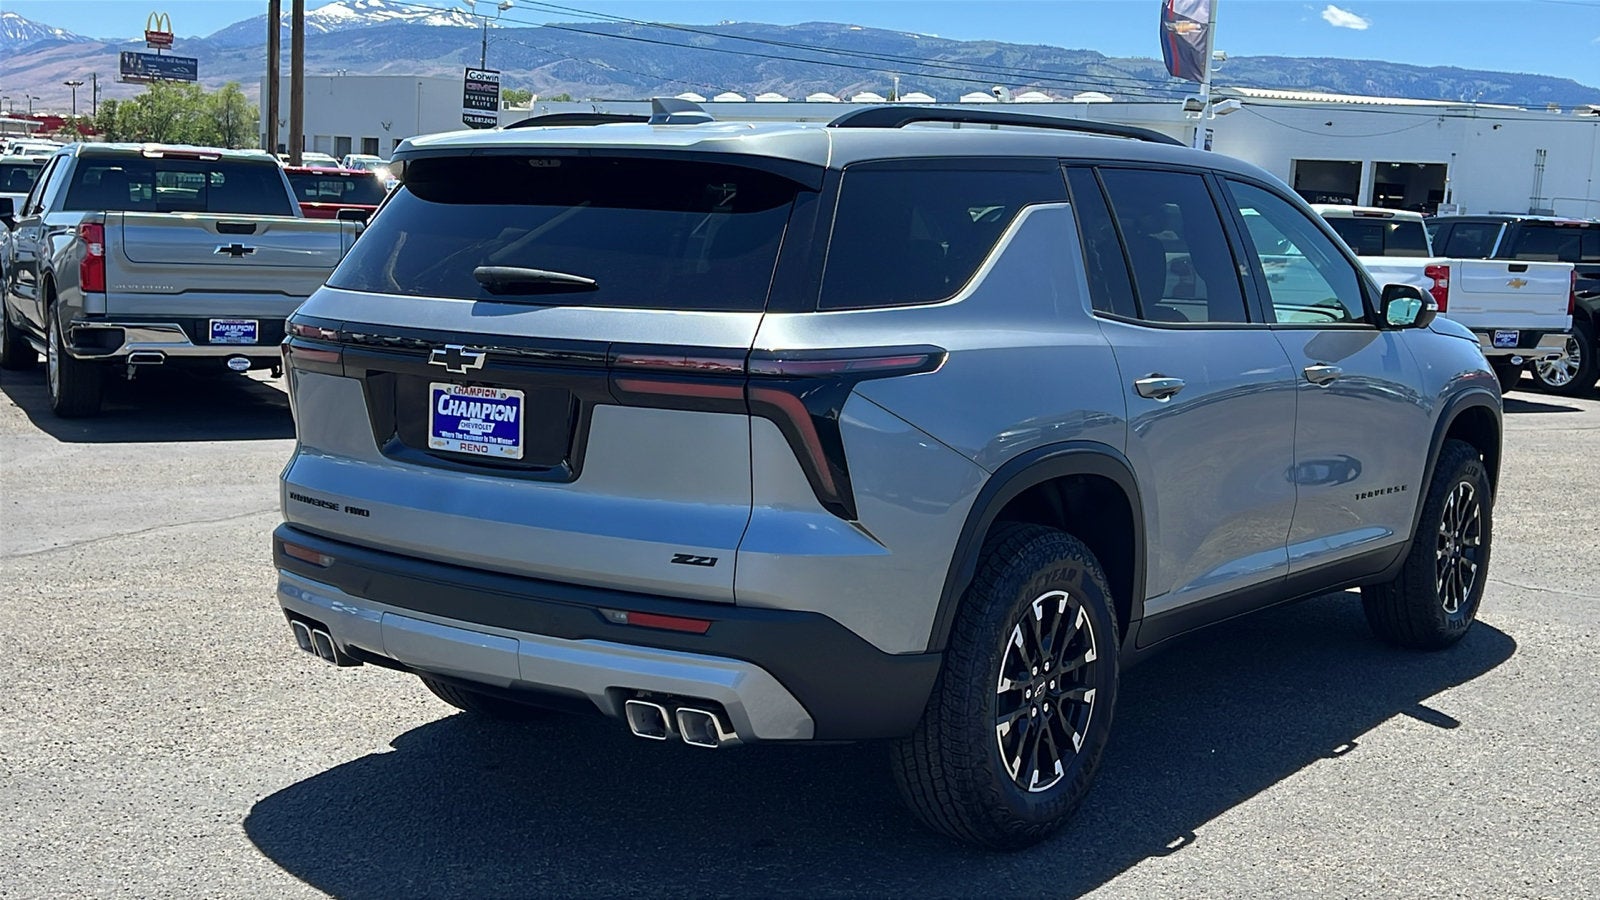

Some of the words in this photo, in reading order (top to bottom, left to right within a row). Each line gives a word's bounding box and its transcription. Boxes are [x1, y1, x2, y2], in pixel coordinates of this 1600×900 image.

[469, 71, 499, 82] Corwin
[466, 83, 498, 92] GMC
[465, 94, 497, 103] BUSINESS
[213, 323, 255, 332] CHAMPION
[454, 386, 497, 398] CHAMPION
[437, 394, 517, 423] CHAMPION
[460, 421, 493, 431] CHEVROLET
[460, 443, 488, 453] RENO
[1355, 484, 1408, 500] TRAVERSE
[289, 492, 340, 511] TRAVERSE
[344, 506, 370, 517] AWD
[671, 553, 718, 567] Z71
